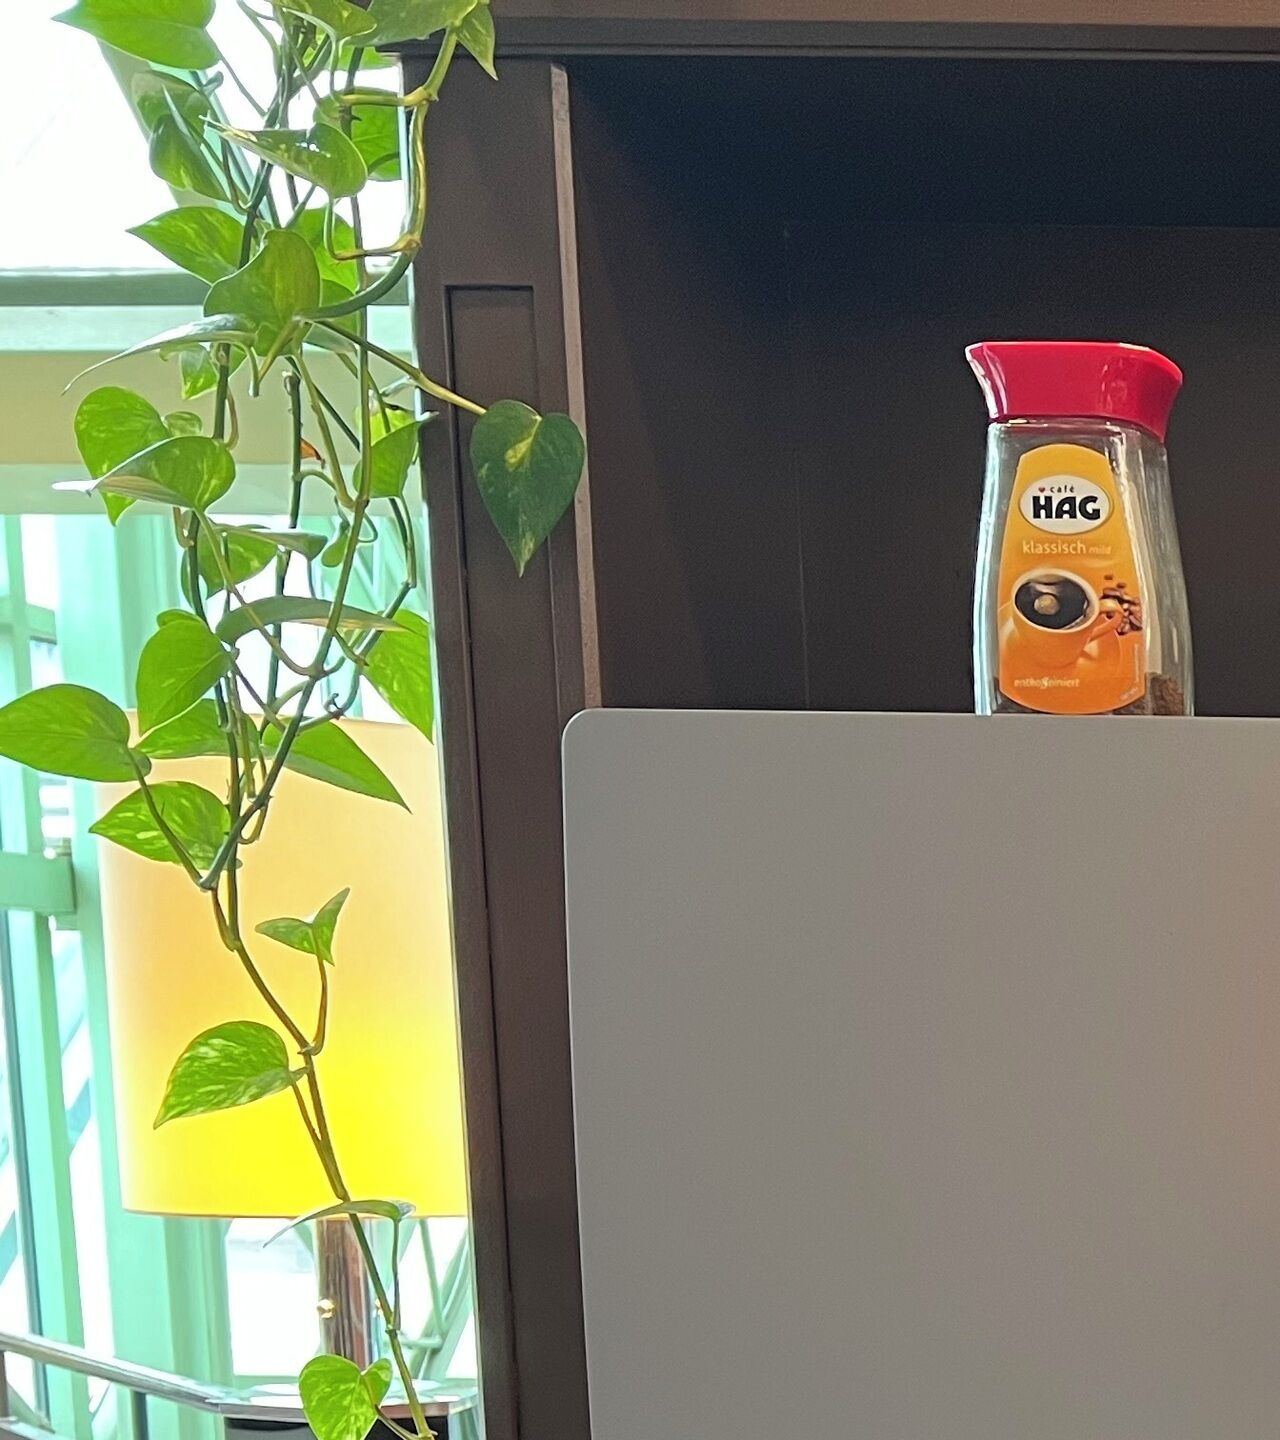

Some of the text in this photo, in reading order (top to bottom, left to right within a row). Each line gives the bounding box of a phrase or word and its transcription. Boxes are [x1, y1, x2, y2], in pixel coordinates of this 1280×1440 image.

[1049, 484, 1076, 494] café
[1031, 495, 1101, 521] HAG
[1022, 540, 1087, 554] klassisch
